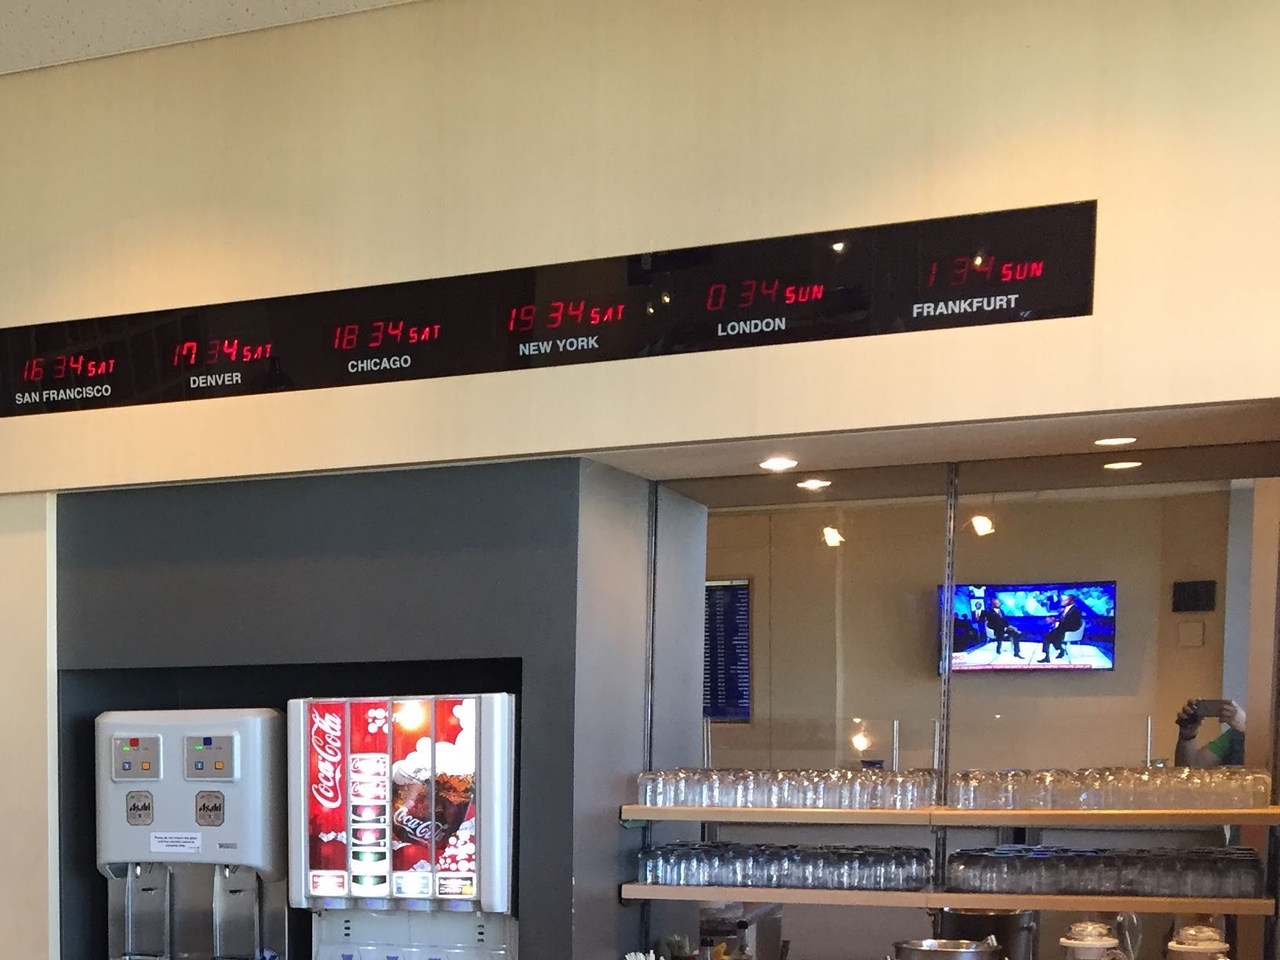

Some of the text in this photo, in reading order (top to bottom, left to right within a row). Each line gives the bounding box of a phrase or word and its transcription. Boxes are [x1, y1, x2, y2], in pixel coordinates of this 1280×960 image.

[1001, 261, 1044, 282] SUN
[785, 284, 824, 304] SUN
[590, 304, 625, 325] SAT
[912, 294, 1020, 318] FRANKFURT
[408, 324, 440, 343] SAT
[718, 317, 786, 336] LONDON
[242, 343, 272, 361] SAT
[519, 335, 600, 356] NEW YORK
[87, 359, 115, 377] SAT
[347, 355, 412, 373] CHICAGO
[190, 372, 242, 389] DENVER
[15, 384, 112, 405] SAN FRANCISCO
